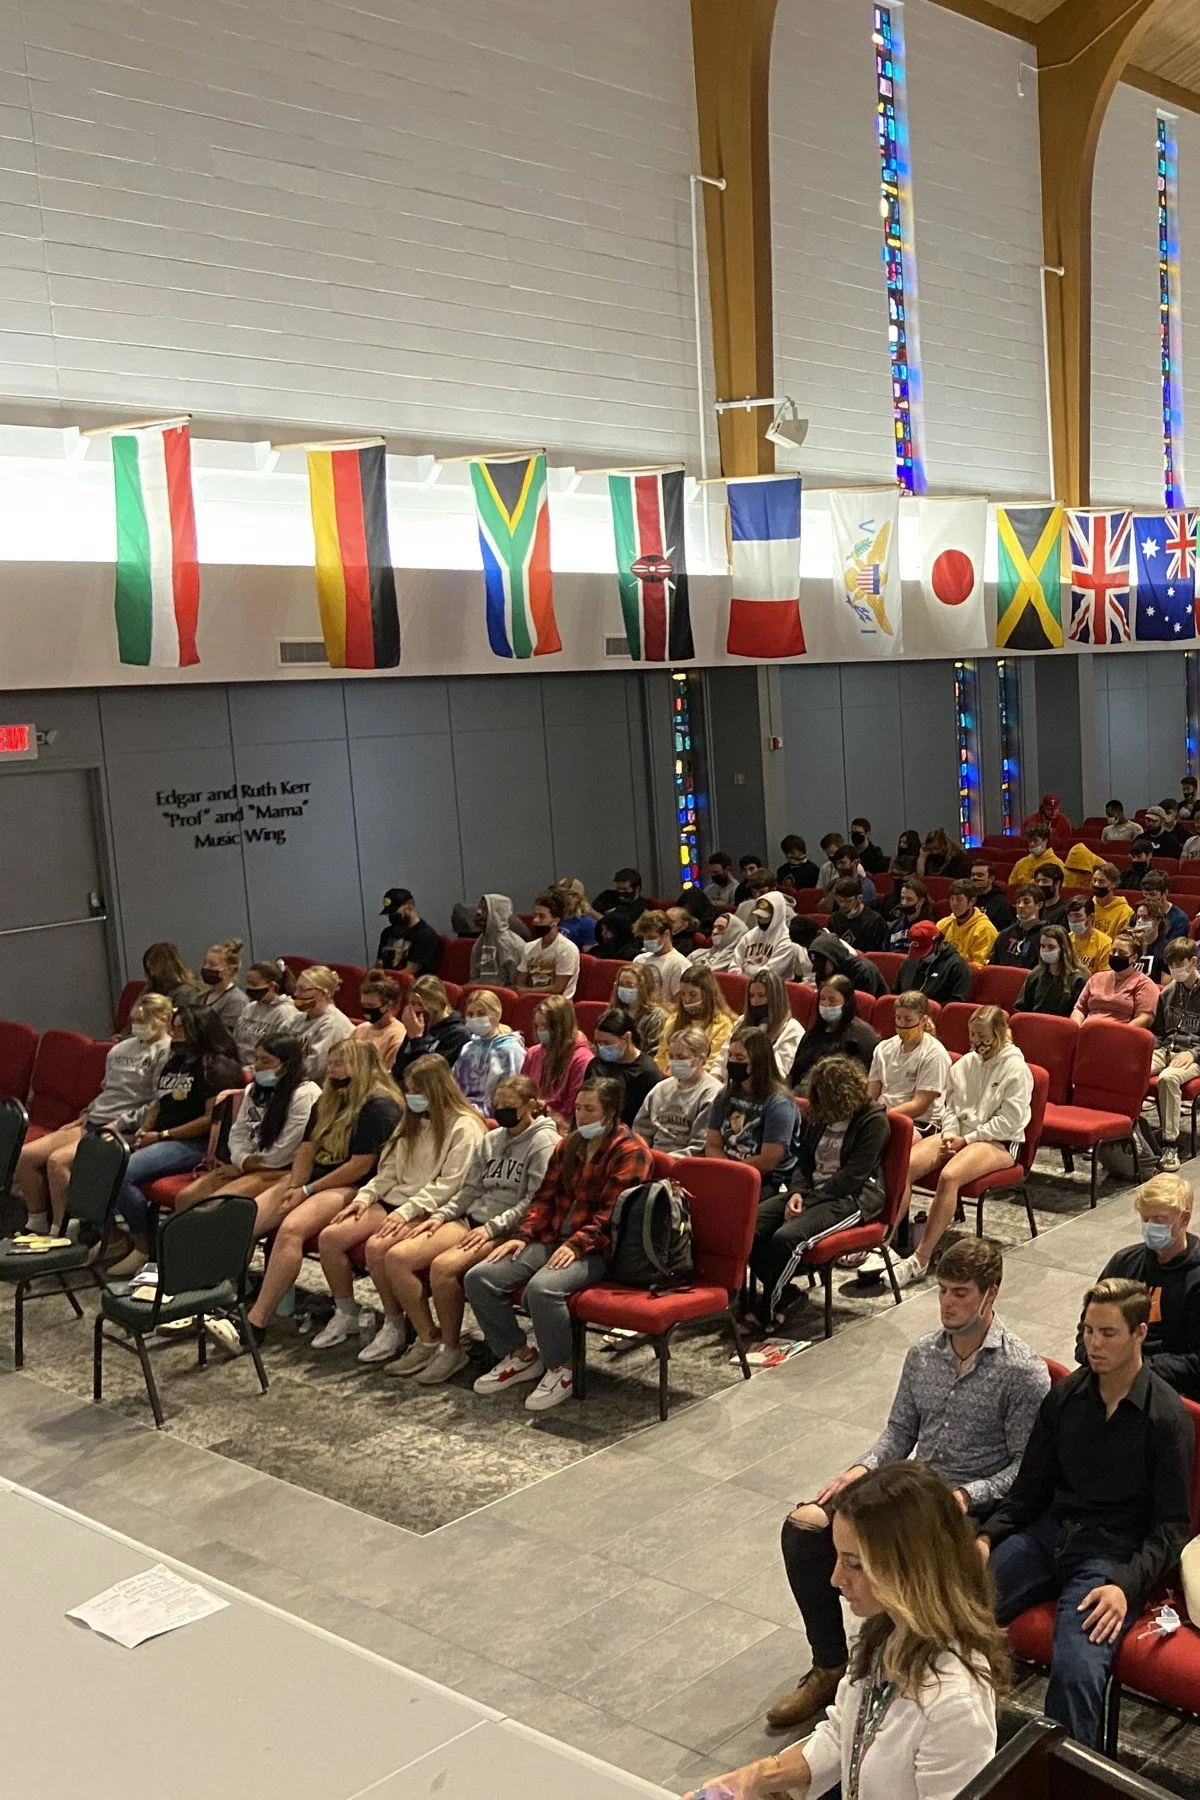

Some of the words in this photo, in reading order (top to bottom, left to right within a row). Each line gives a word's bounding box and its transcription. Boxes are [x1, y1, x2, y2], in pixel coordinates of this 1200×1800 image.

[156, 789, 202, 809] Edgar
[207, 784, 238, 801] and
[241, 781, 277, 799] Ruth
[280, 780, 311, 796] Kerr
[215, 806, 244, 824] and
[194, 830, 241, 849] Music
[244, 827, 287, 845] Wing
